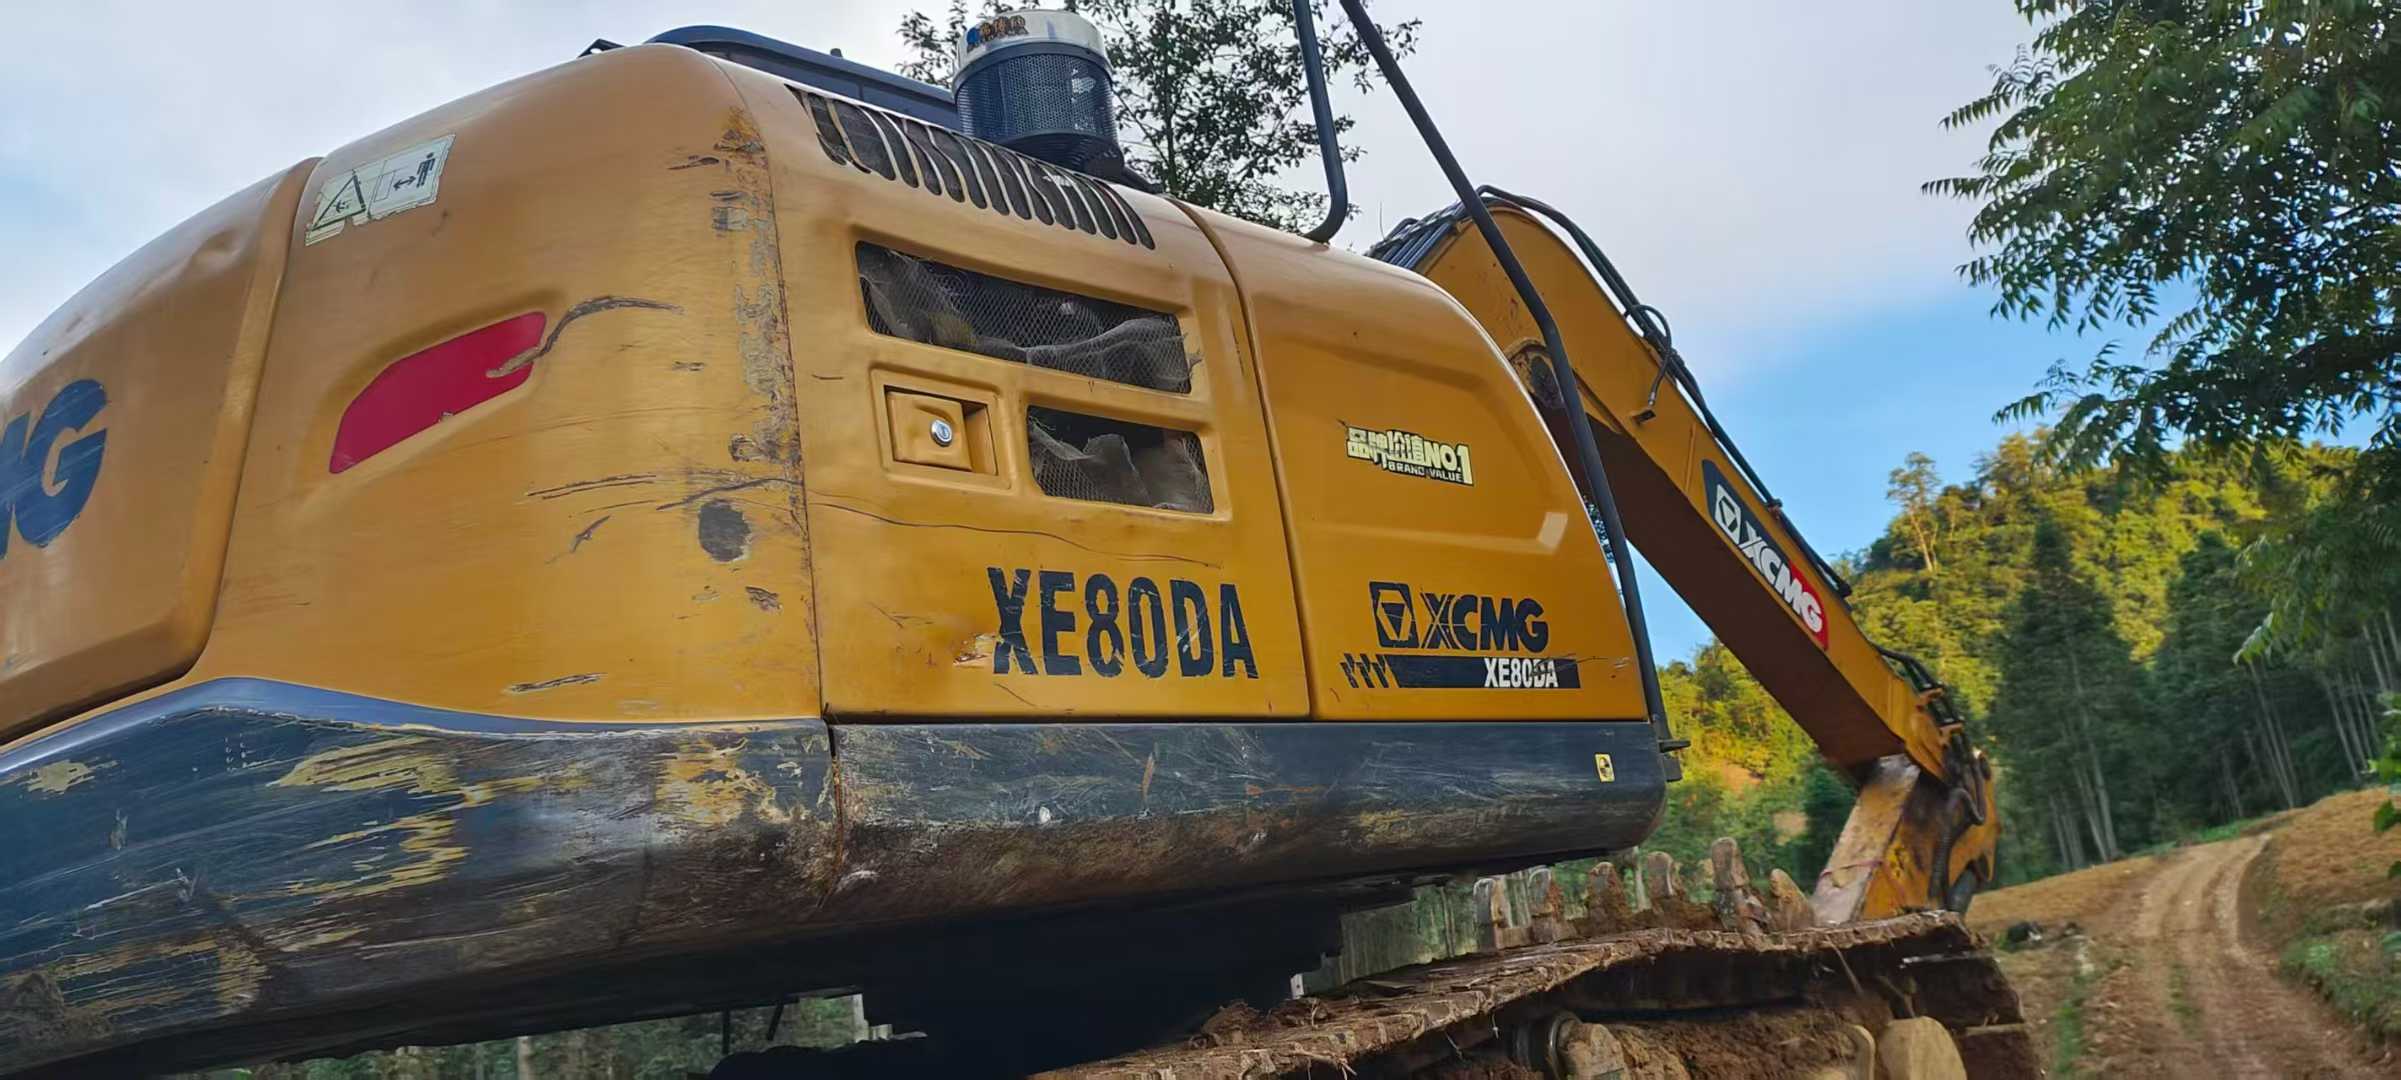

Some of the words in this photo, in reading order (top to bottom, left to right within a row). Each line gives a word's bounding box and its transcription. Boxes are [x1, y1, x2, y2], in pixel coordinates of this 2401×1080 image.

[1388, 461, 1425, 476] BRAND
[1429, 467, 1463, 483] VALUE
[1739, 520, 1823, 633] XCMG
[987, 567, 1259, 679] XE80DA
[1420, 592, 1549, 653] XCMG
[1484, 657, 1559, 688] XE80DA
